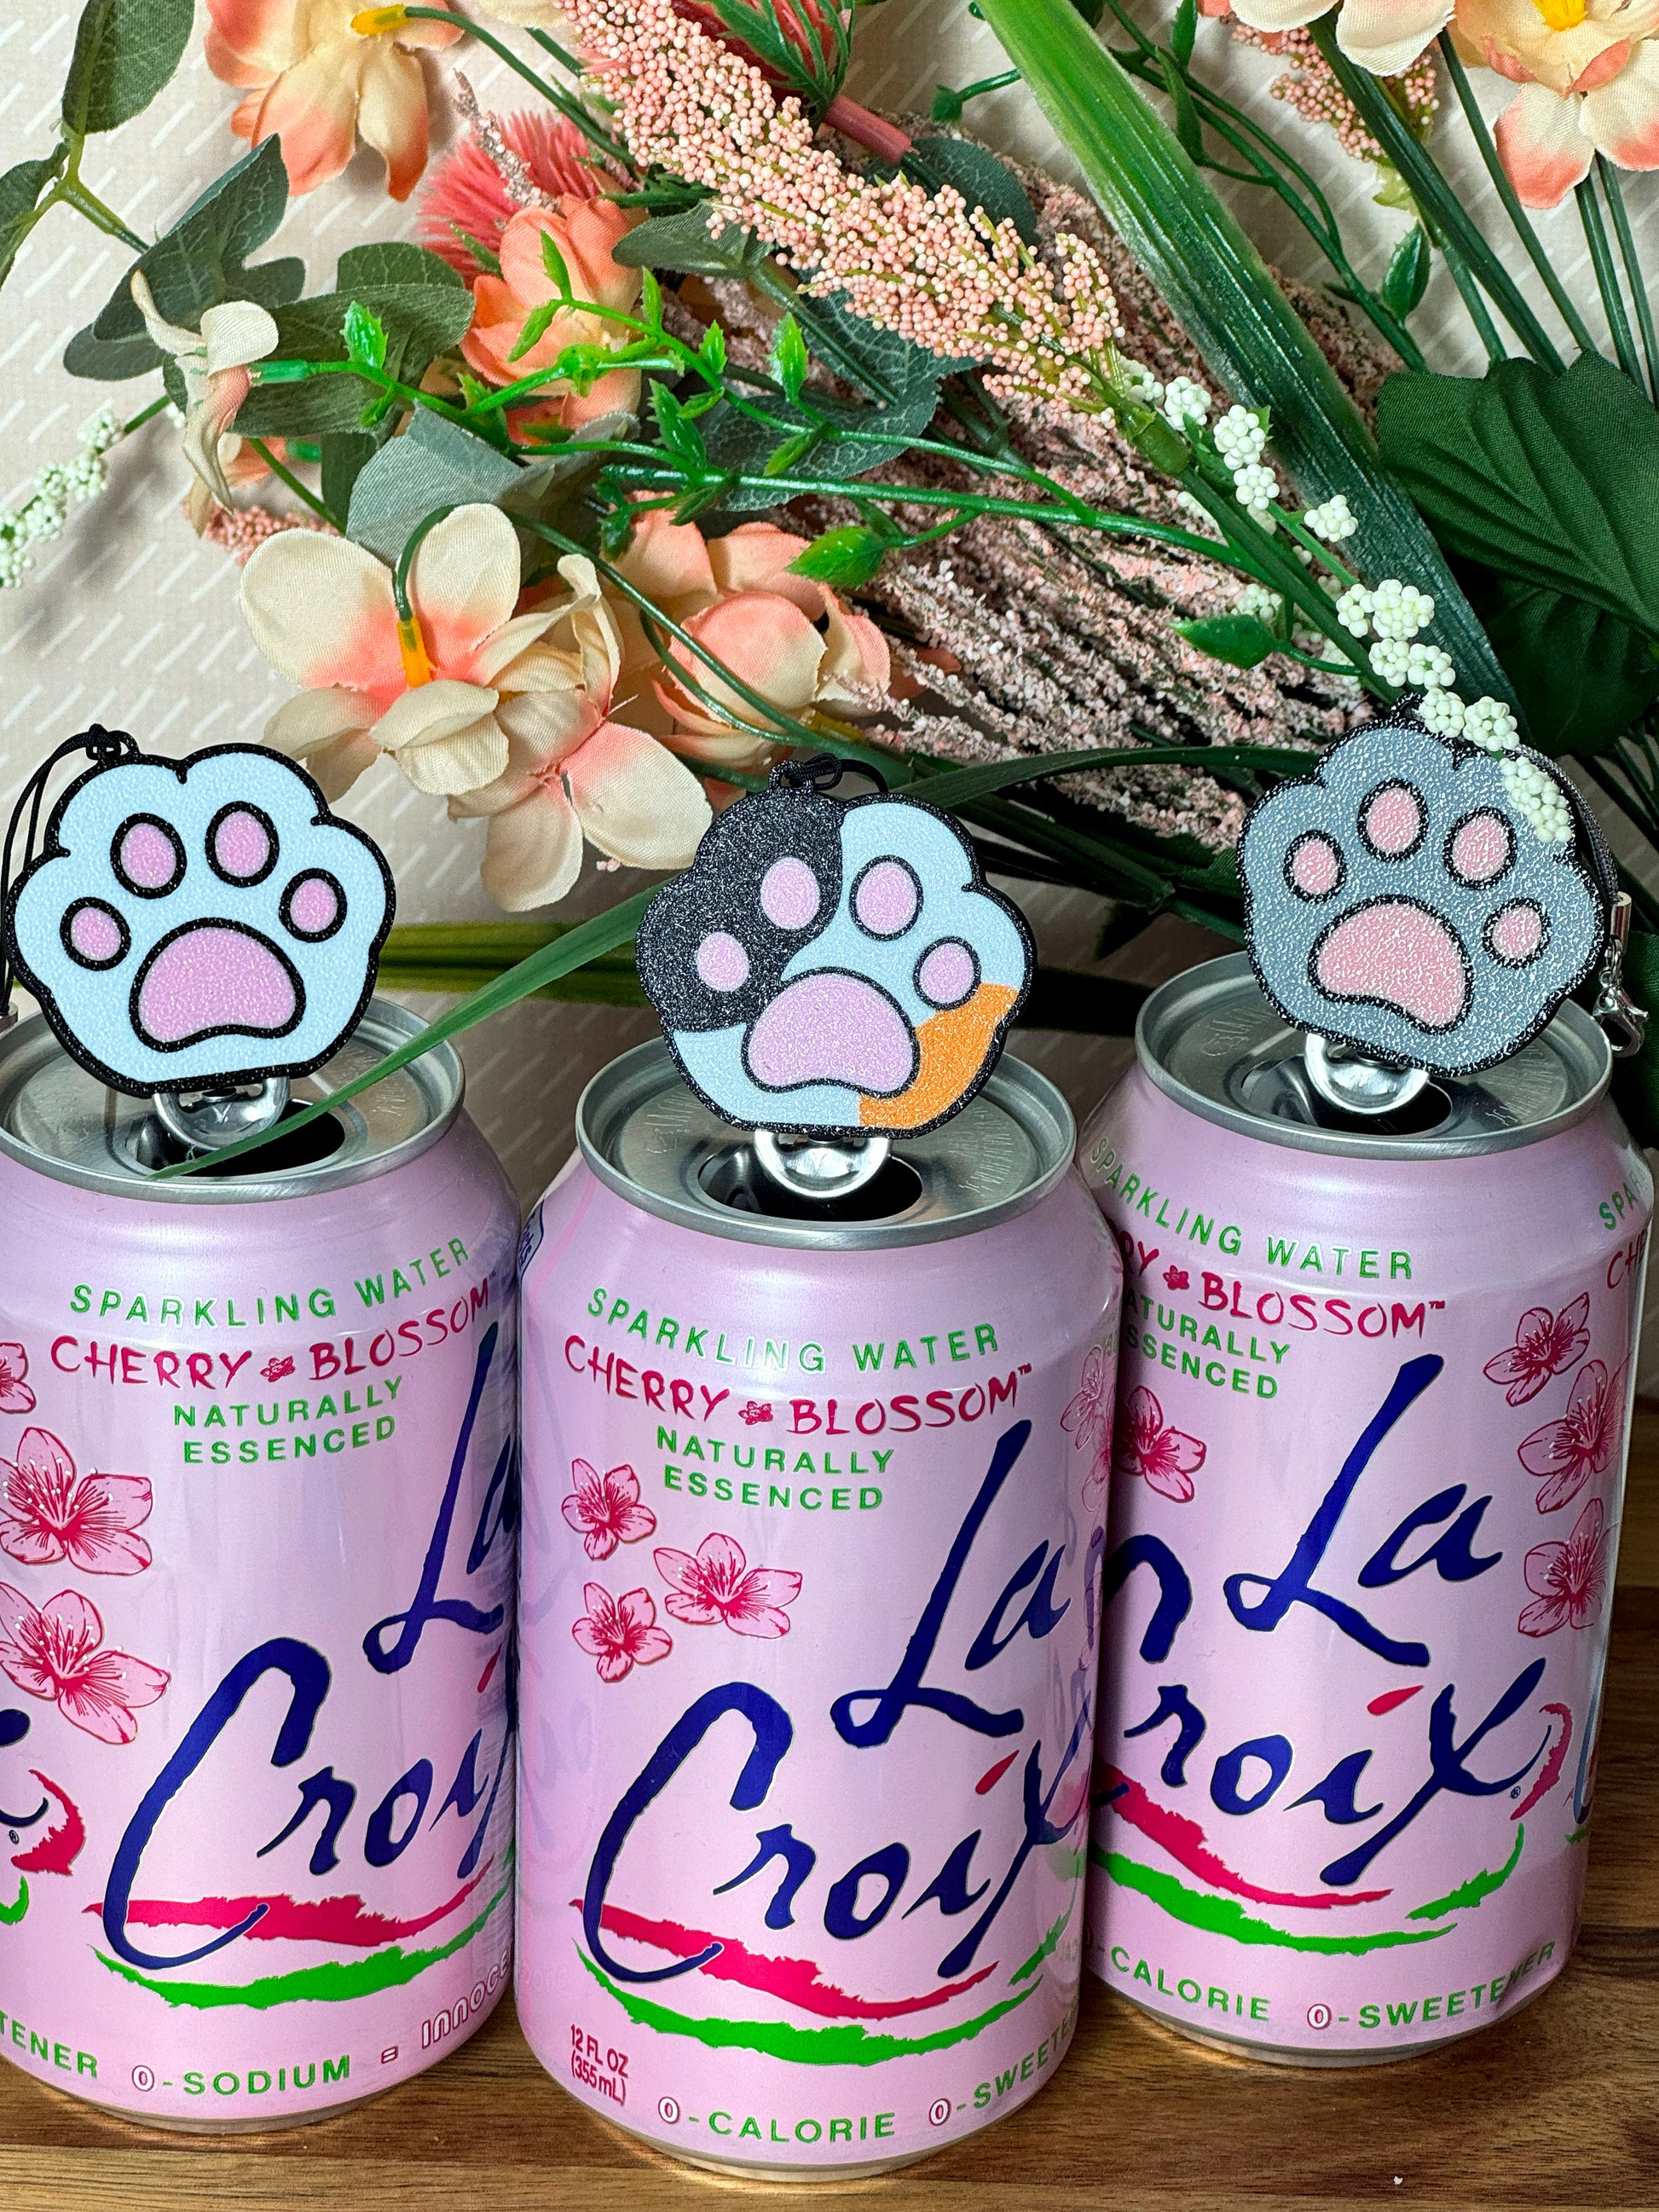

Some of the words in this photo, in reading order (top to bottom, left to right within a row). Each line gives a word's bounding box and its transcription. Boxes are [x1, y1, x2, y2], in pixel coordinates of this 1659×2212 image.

[1090, 1137, 1242, 1256] SPARKLING
[1266, 1236, 1413, 1280] WATER
[70, 1283, 337, 1328] SPARKLING
[354, 1237, 470, 1308] WATER
[51, 1335, 252, 1390] CHERRY
[587, 1288, 825, 1374] SPARKLING
[853, 1323, 999, 1374] WATER
[1123, 1288, 1291, 1365] ATURALLY
[1126, 1323, 1278, 1400] SSENCED
[173, 1375, 403, 1428] NATURALLY
[564, 1334, 730, 1422] CHERRY
[184, 1416, 396, 1464] ESSENCED
[656, 1425, 894, 1474] NATURALLY
[664, 1465, 883, 1510] ESSENCED
[1223, 1353, 1502, 1666] La
[830, 1419, 1071, 1749] La
[582, 1682, 1092, 1983] Croix
[1086, 1924, 1270, 2024] -CALORIE
[131, 2054, 350, 2096] 0-SODIUM
[571, 2024, 583, 2053] 12
[587, 2035, 603, 2065] FL
[607, 2048, 629, 2078] OZ
[657, 2096, 895, 2145] 0-CALORIE
